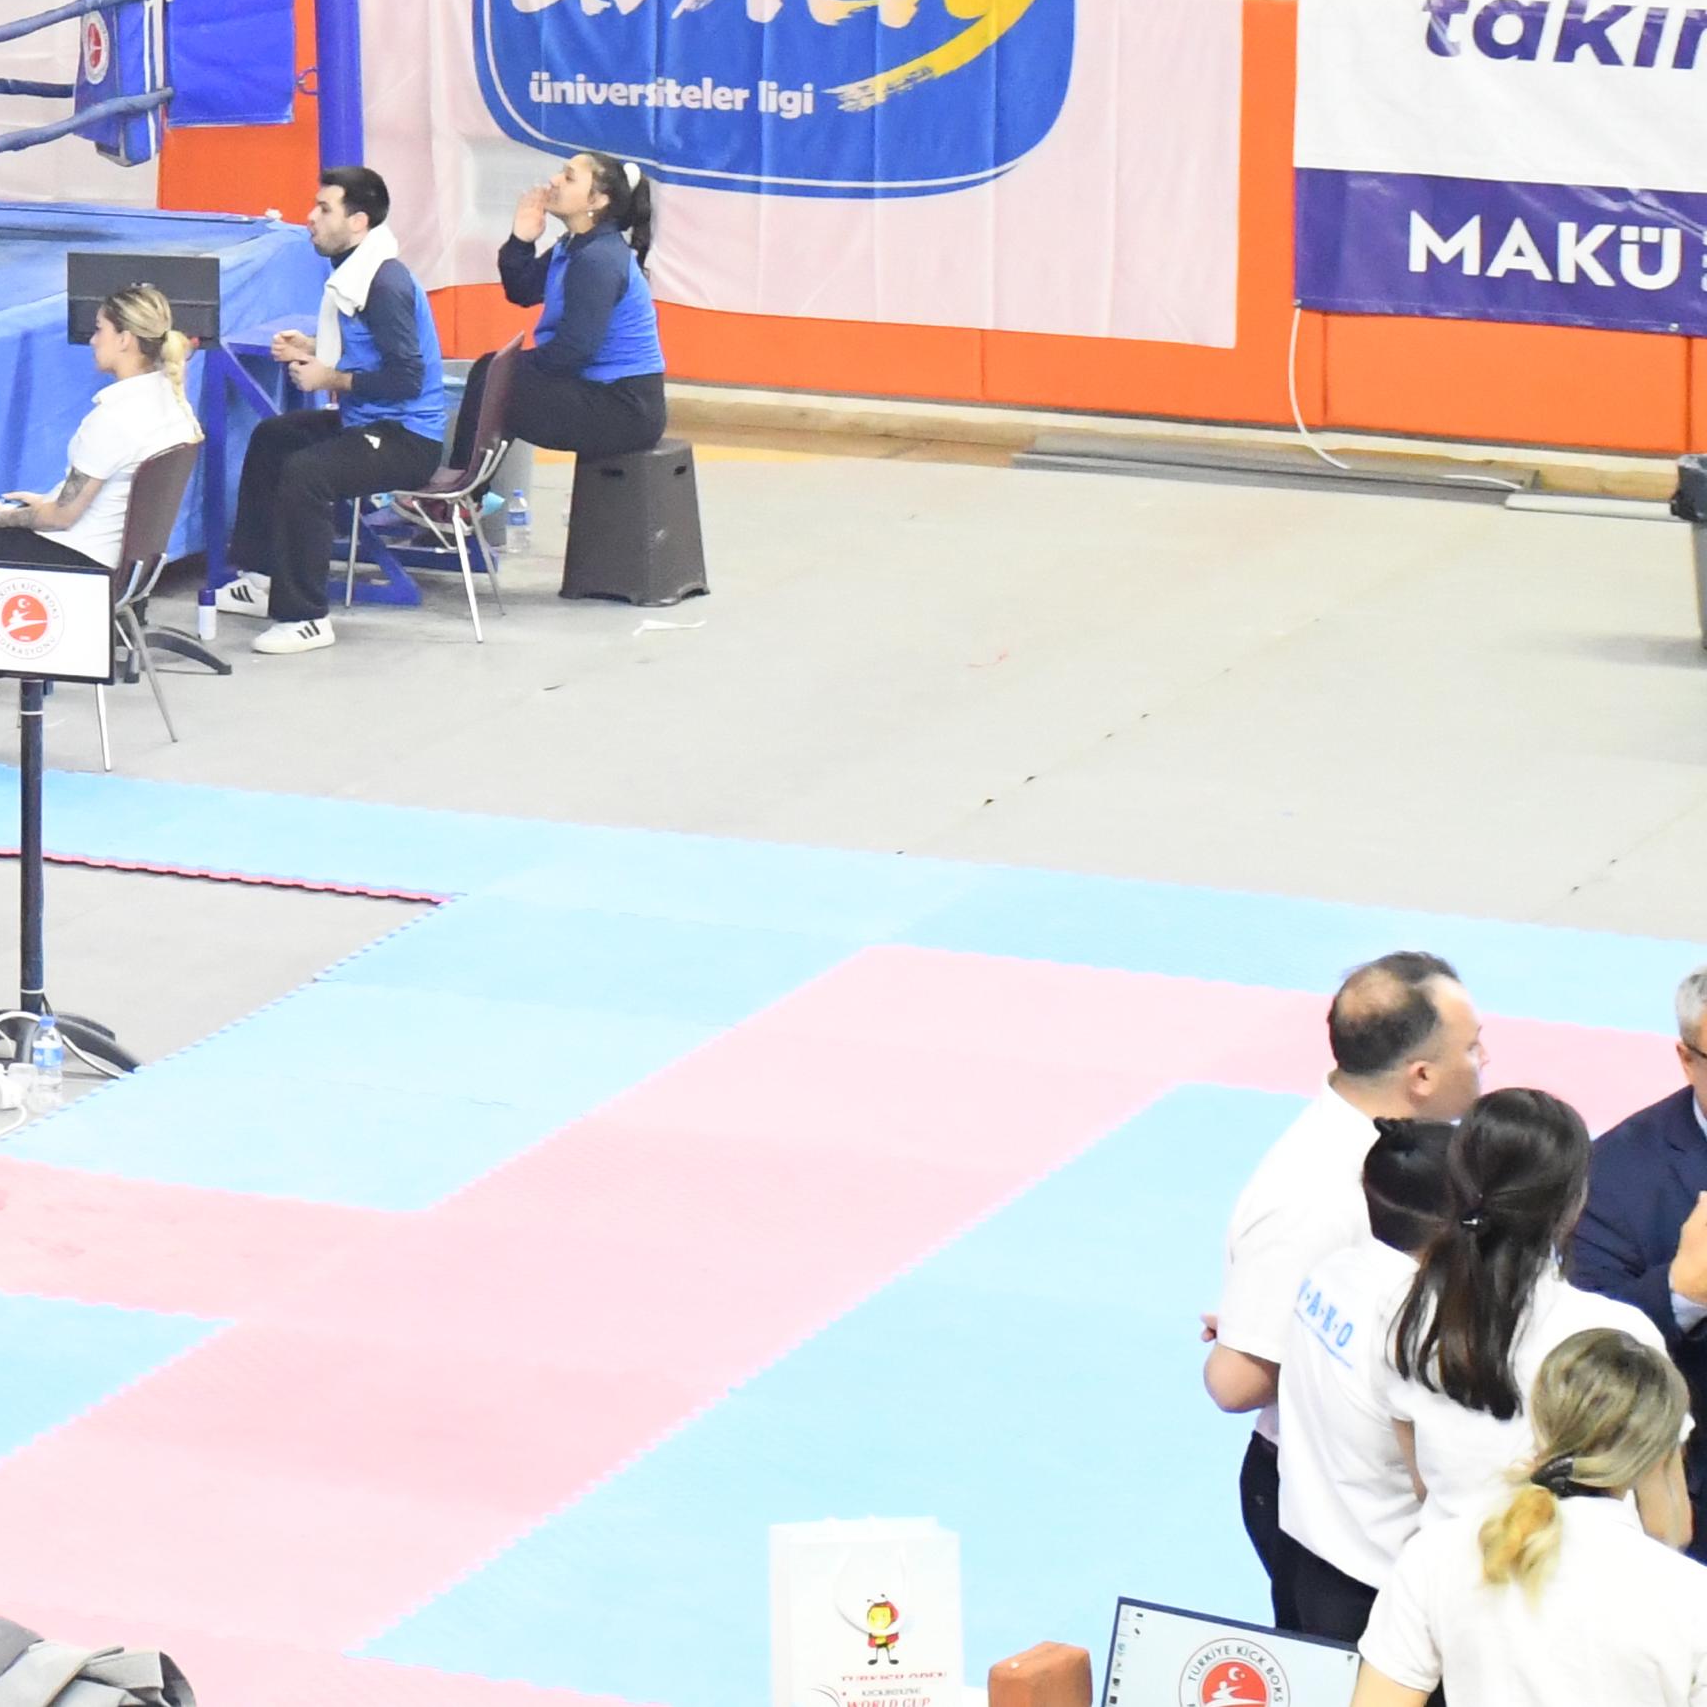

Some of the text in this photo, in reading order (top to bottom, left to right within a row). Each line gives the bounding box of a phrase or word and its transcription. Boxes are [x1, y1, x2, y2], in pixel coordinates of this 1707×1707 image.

[529, 71, 815, 120] üniversiteler ligi
[1408, 209, 1683, 292] MAKÜ
[1265, 1666, 1285, 1704] BOKS
